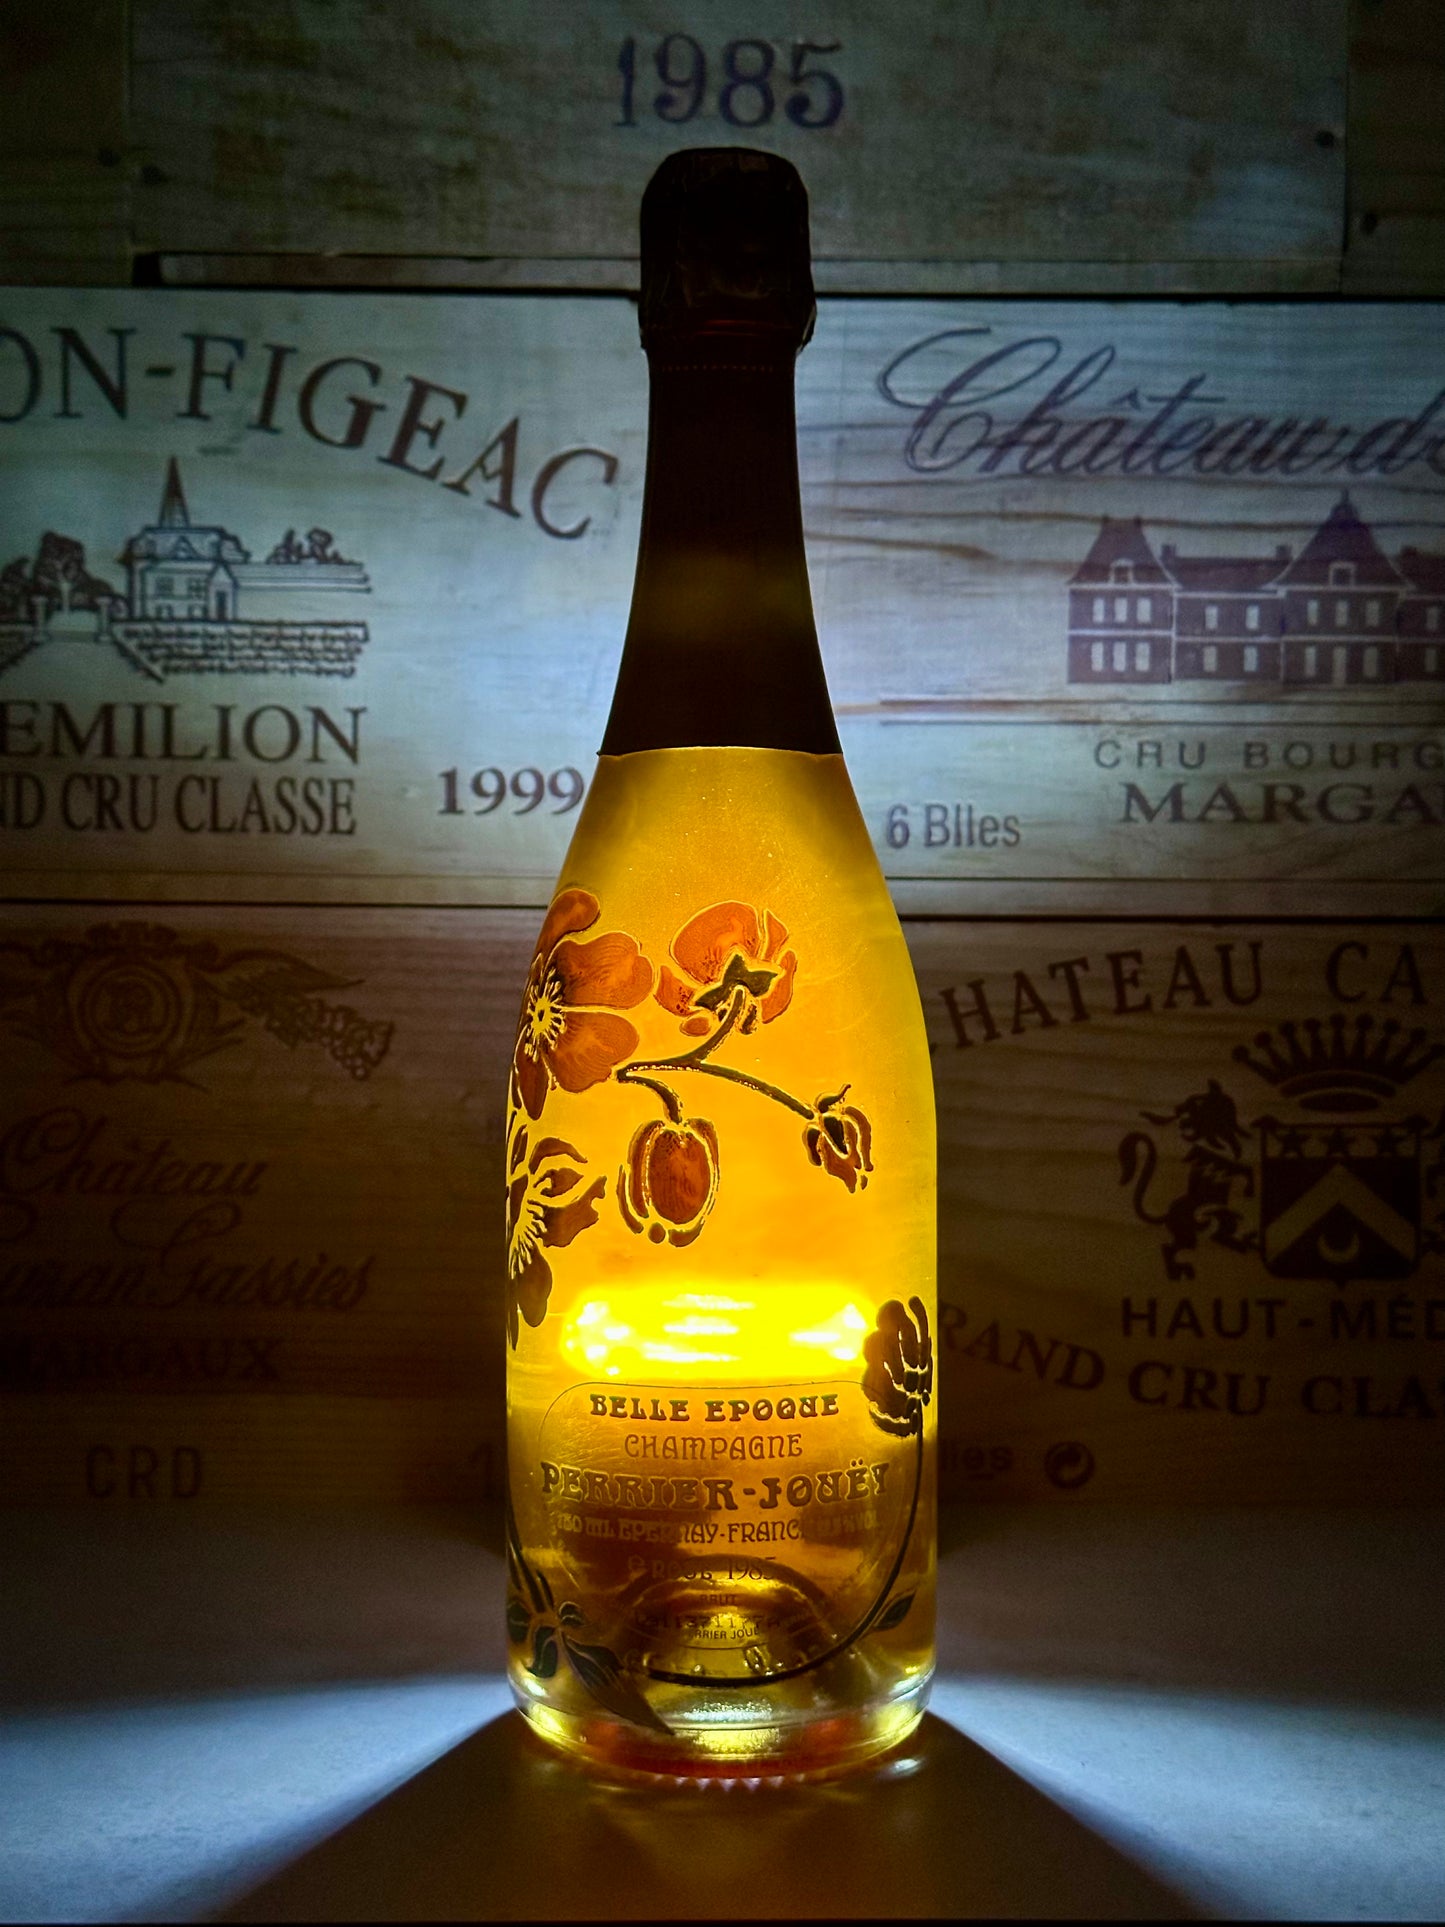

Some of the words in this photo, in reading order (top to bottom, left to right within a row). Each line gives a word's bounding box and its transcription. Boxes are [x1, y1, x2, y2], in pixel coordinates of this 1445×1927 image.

[613, 32, 845, 129] 1985
[0, 700, 367, 765] EMILION
[1094, 740, 1207, 770] CRU
[1244, 740, 1444, 770] BOURG
[61, 772, 160, 833] CRU
[174, 774, 357, 837] CLASSE
[437, 765, 586, 817] 1999
[886, 808, 911, 849] 6
[923, 804, 1021, 849] Blles
[929, 940, 1265, 1056] HATEAU
[1325, 940, 1429, 1004] CA
[589, 1393, 690, 1422] BELLE
[704, 1393, 840, 1423] EPOQUE
[1127, 1360, 1271, 1417] CRU
[1300, 1375, 1445, 1419] CLA
[85, 1442, 204, 1500] CRD
[624, 1433, 803, 1461] CHAMPAGNE
[540, 1458, 890, 1512] PERRIER-JOUËT
[617, 1517, 804, 1544] EPERNAY-FRANC
